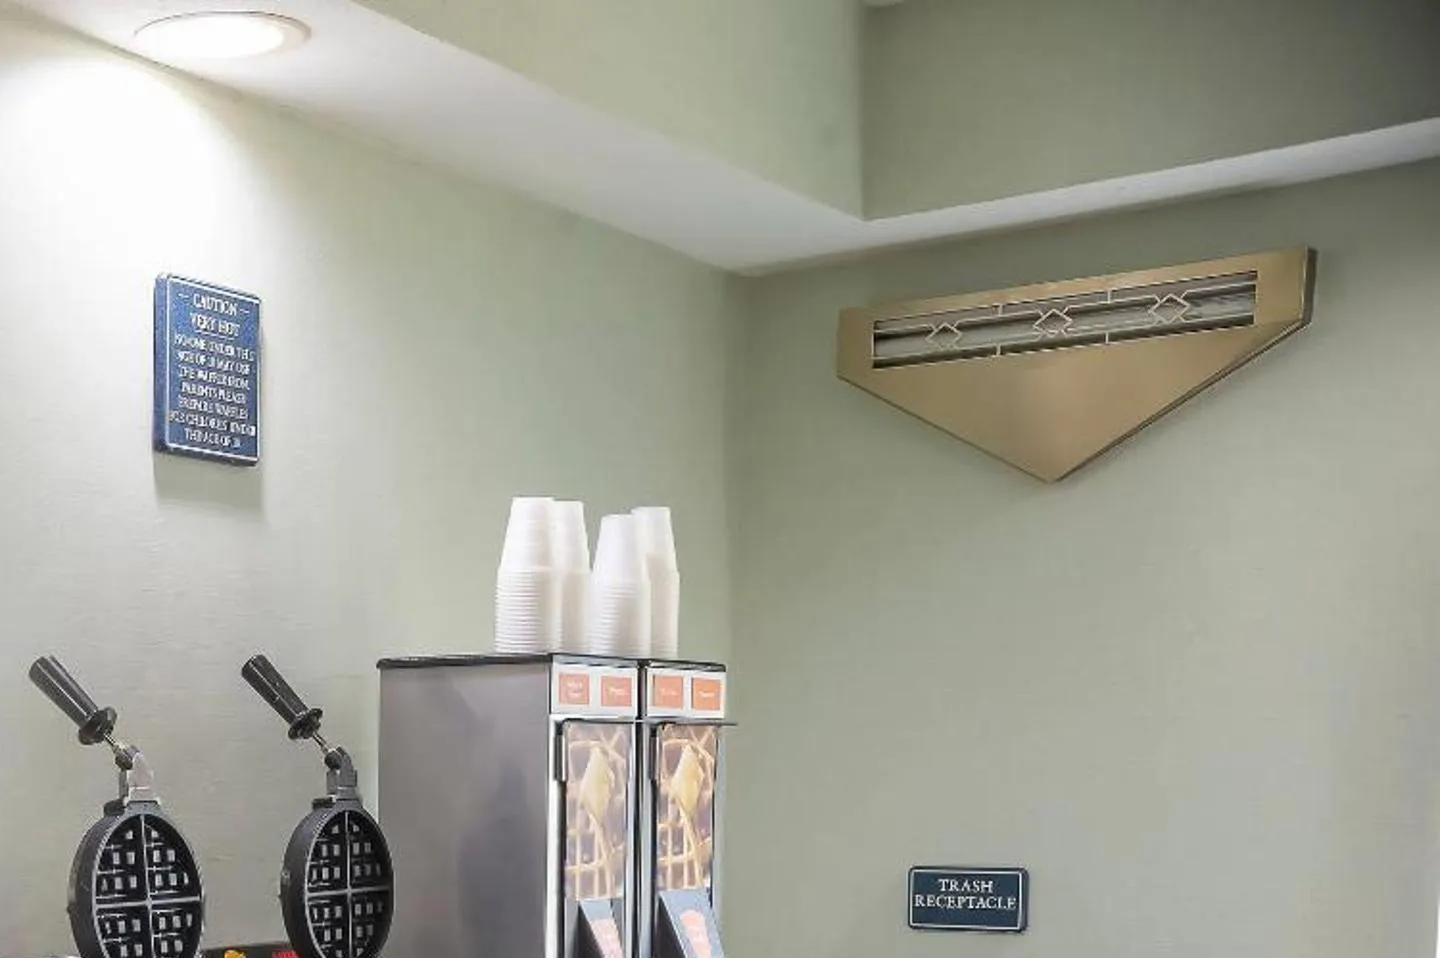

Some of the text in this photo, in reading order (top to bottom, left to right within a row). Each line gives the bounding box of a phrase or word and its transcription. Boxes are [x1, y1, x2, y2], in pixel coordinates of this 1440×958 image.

[193, 293, 237, 316] CAUTION
[937, 878, 994, 894] TRASH
[913, 893, 1017, 911] RECEPTACLE
